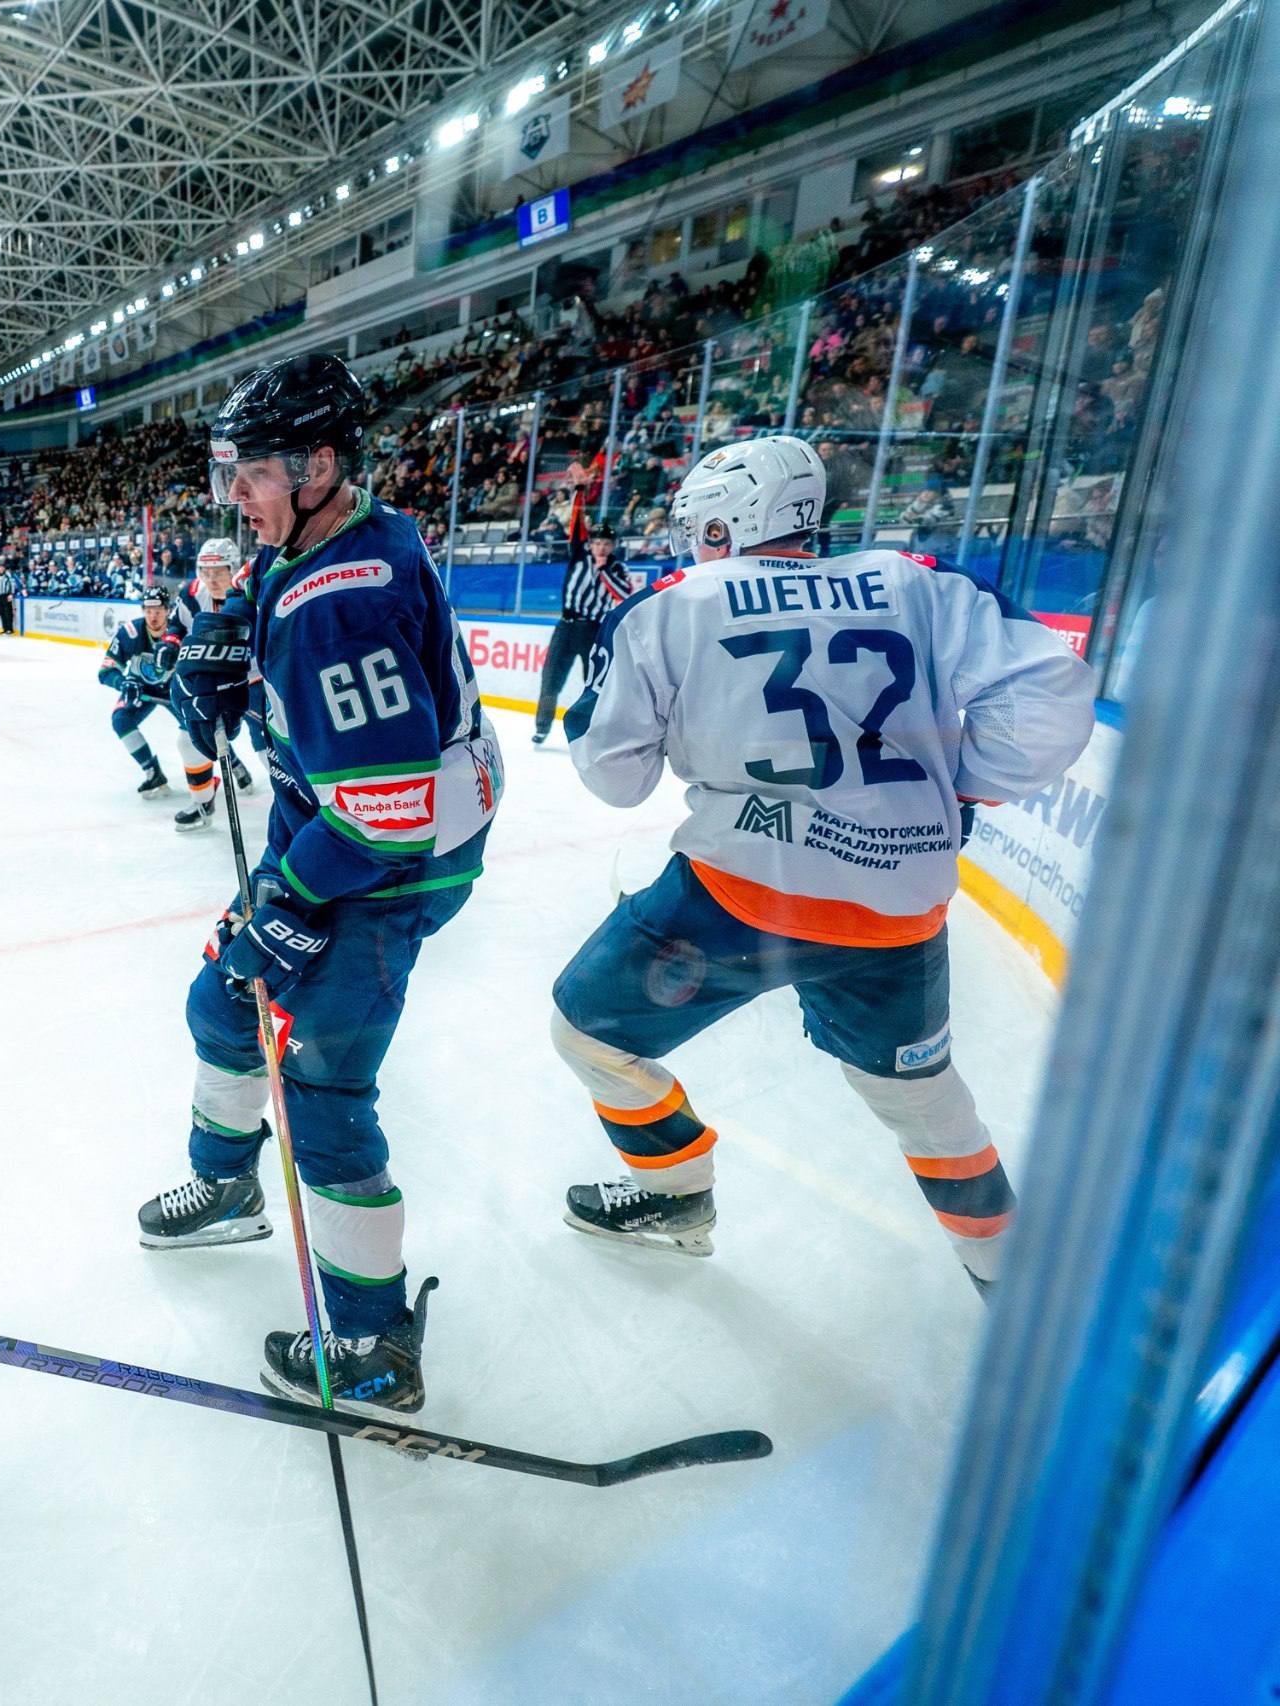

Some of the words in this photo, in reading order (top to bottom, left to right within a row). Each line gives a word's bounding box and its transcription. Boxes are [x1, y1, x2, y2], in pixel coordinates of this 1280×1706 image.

[793, 499, 815, 529] 32
[281, 566, 382, 608] OLIMPBET
[725, 570, 889, 619] ШЕТЛЕ
[468, 628, 549, 673] Банк
[320, 647, 411, 733] 66
[718, 627, 928, 790] 32
[353, 801, 393, 815] Альфа
[394, 798, 422, 811] Банк
[804, 836, 902, 871] КОМБИНАТ
[807, 823, 954, 856] МЕТАЛЛУРГИЧЕСКИЙ
[262, 918, 329, 954] BAU
[21, 1356, 172, 1398] RIBCOR
[118, 1361, 203, 1391] RIBCOR
